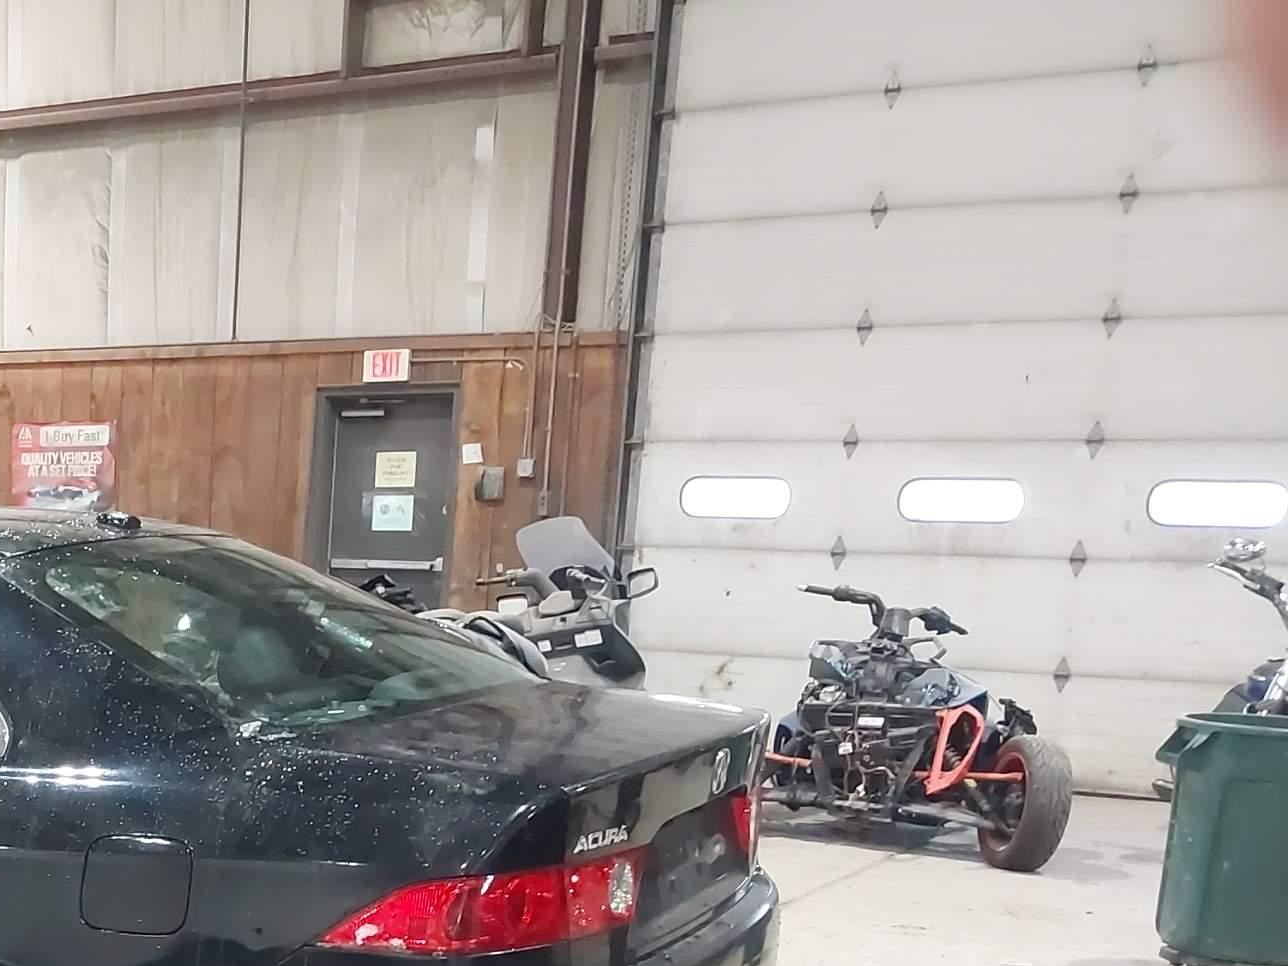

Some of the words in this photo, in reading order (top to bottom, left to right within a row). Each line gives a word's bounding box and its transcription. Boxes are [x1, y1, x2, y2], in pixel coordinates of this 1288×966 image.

[372, 352, 401, 378] EXIT
[21, 451, 59, 465] QUALITY
[60, 451, 102, 465] VEHICLES
[27, 464, 41, 477] AT
[41, 464, 49, 477] A
[49, 464, 66, 477] SET
[572, 824, 629, 854] ACURA
